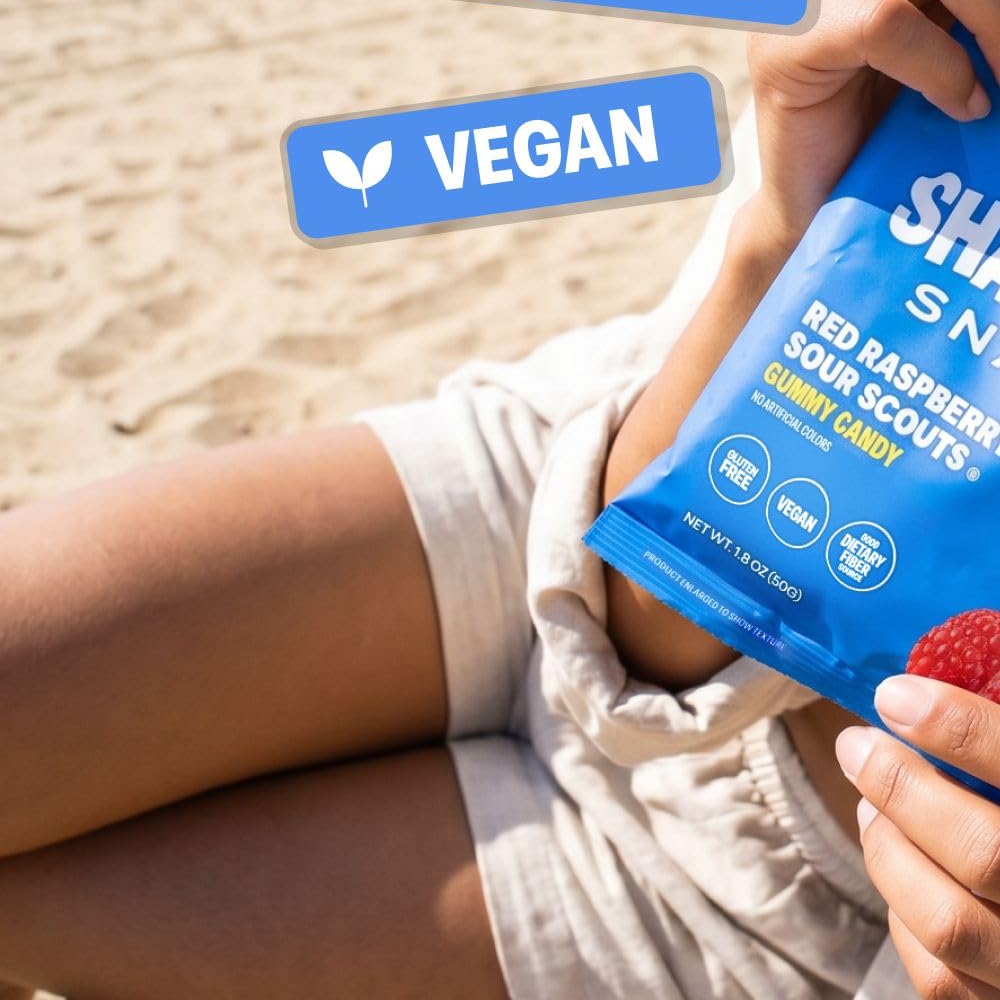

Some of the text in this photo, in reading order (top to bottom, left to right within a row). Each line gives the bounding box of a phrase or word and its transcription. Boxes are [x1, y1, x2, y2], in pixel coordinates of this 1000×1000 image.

[801, 300, 860, 351] RED
[784, 331, 860, 397] SOUR
[750, 389, 833, 452] NO ARTIFICIAL COLORS
[763, 361, 904, 468] GUMMY CANDY
[719, 458, 753, 491] FREE
[727, 449, 759, 478] GLUTEN
[776, 494, 818, 533] VEGAN
[683, 512, 803, 602] NET WT. 1.8 OZ (50G)
[840, 533, 887, 568] DIETARY
[860, 533, 880, 549] GOOD
[837, 563, 863, 583] SOURCE
[840, 549, 871, 577] FIBER
[643, 551, 681, 583] PRODUCT
[680, 579, 719, 610] ENLARGED
[718, 605, 729, 617] TO
[728, 612, 753, 631] SHOW
